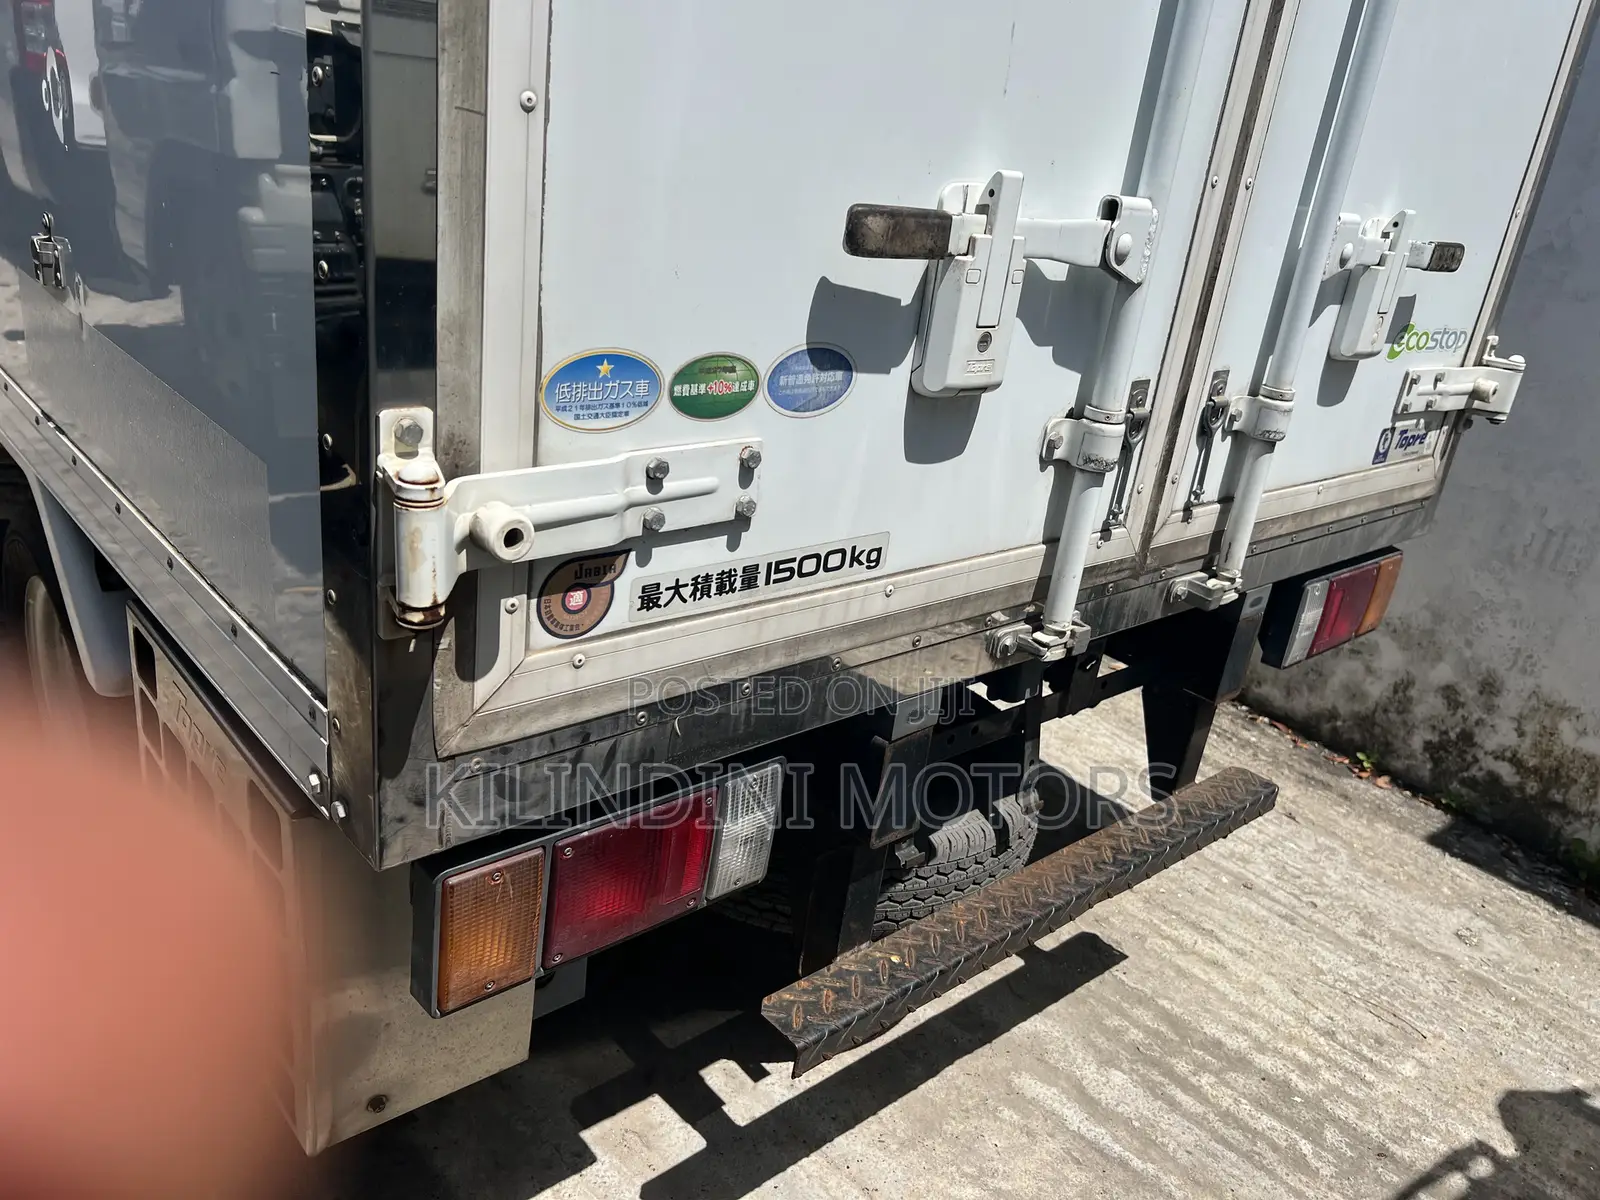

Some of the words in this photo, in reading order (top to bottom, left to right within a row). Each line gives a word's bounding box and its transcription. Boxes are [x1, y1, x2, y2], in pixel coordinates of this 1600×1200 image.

[1386, 322, 1468, 360] ecostop
[554, 379, 650, 403] 低排出ガス車
[574, 563, 617, 580] JABIA
